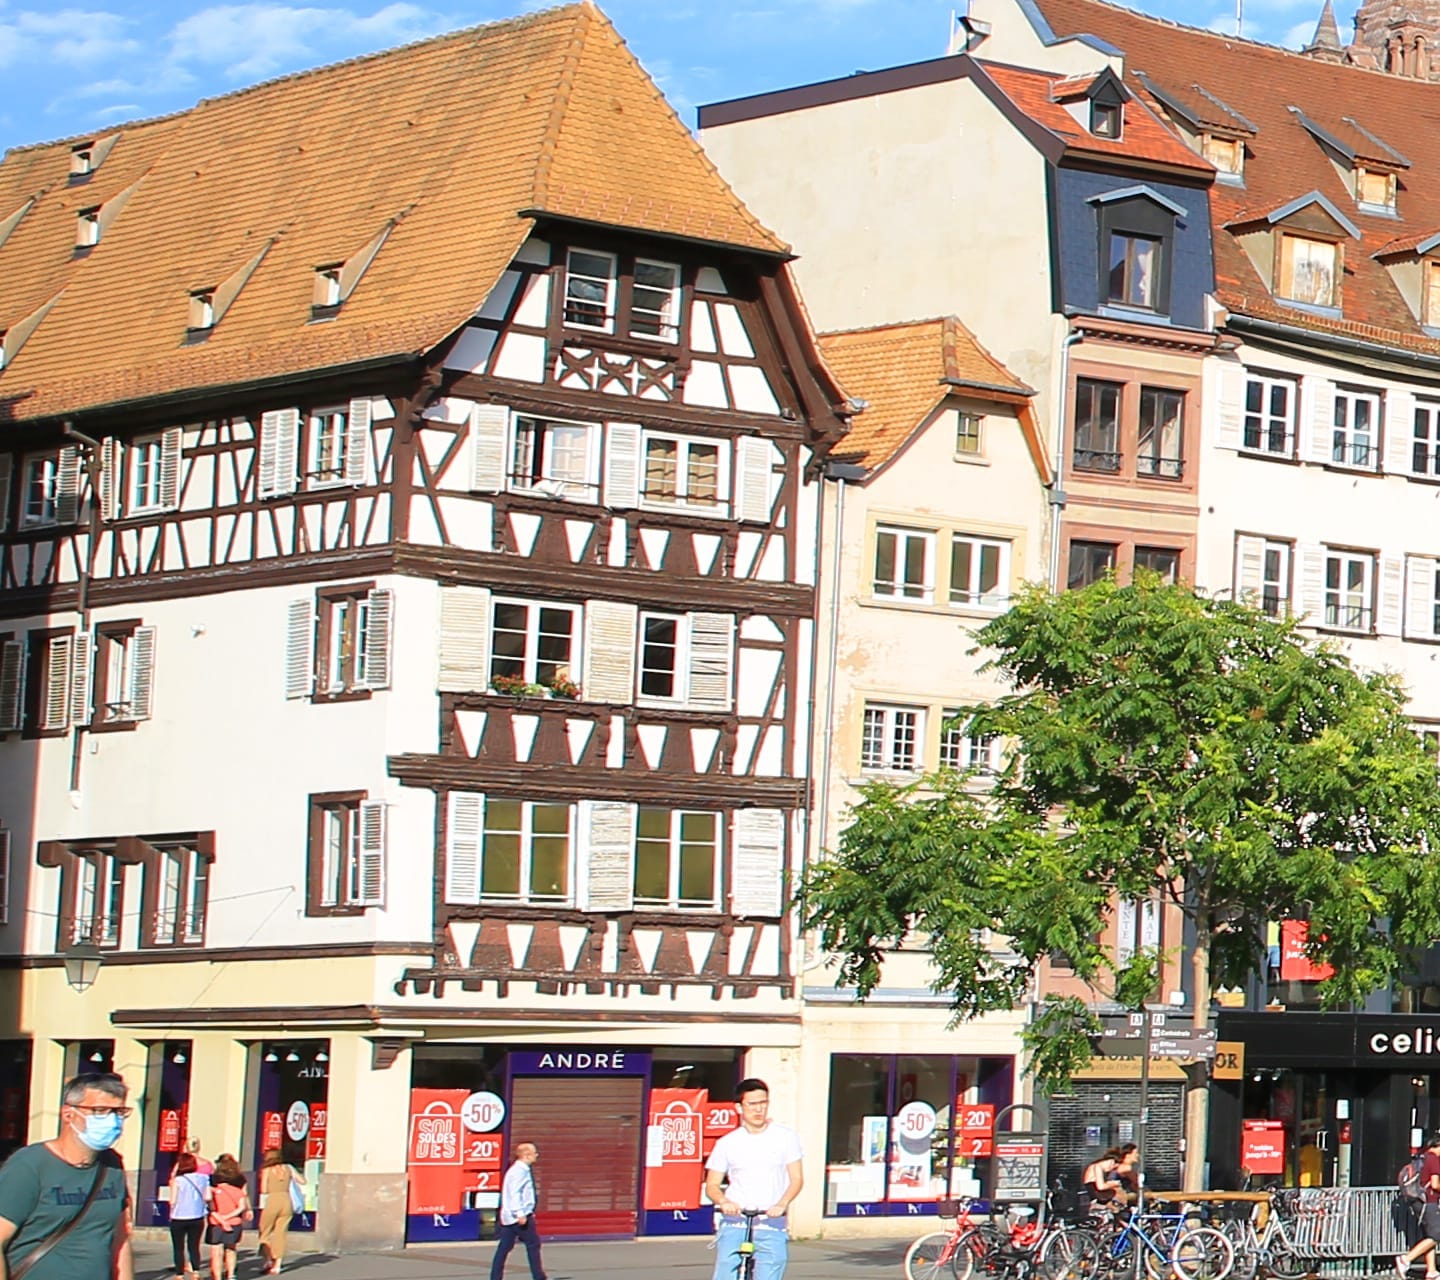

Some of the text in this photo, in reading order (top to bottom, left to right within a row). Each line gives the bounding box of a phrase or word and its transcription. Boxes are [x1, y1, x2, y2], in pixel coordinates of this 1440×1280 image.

[538, 1049, 625, 1069] ANDRÉ
[1215, 1052, 1239, 1069] OR
[311, 1110, 326, 1127] -20
[464, 1103, 502, 1124] -50%
[901, 1113, 933, 1131] -50%
[964, 1111, 991, 1126] -20%
[418, 1132, 456, 1144] SOLDES
[464, 1140, 499, 1158] -20%
